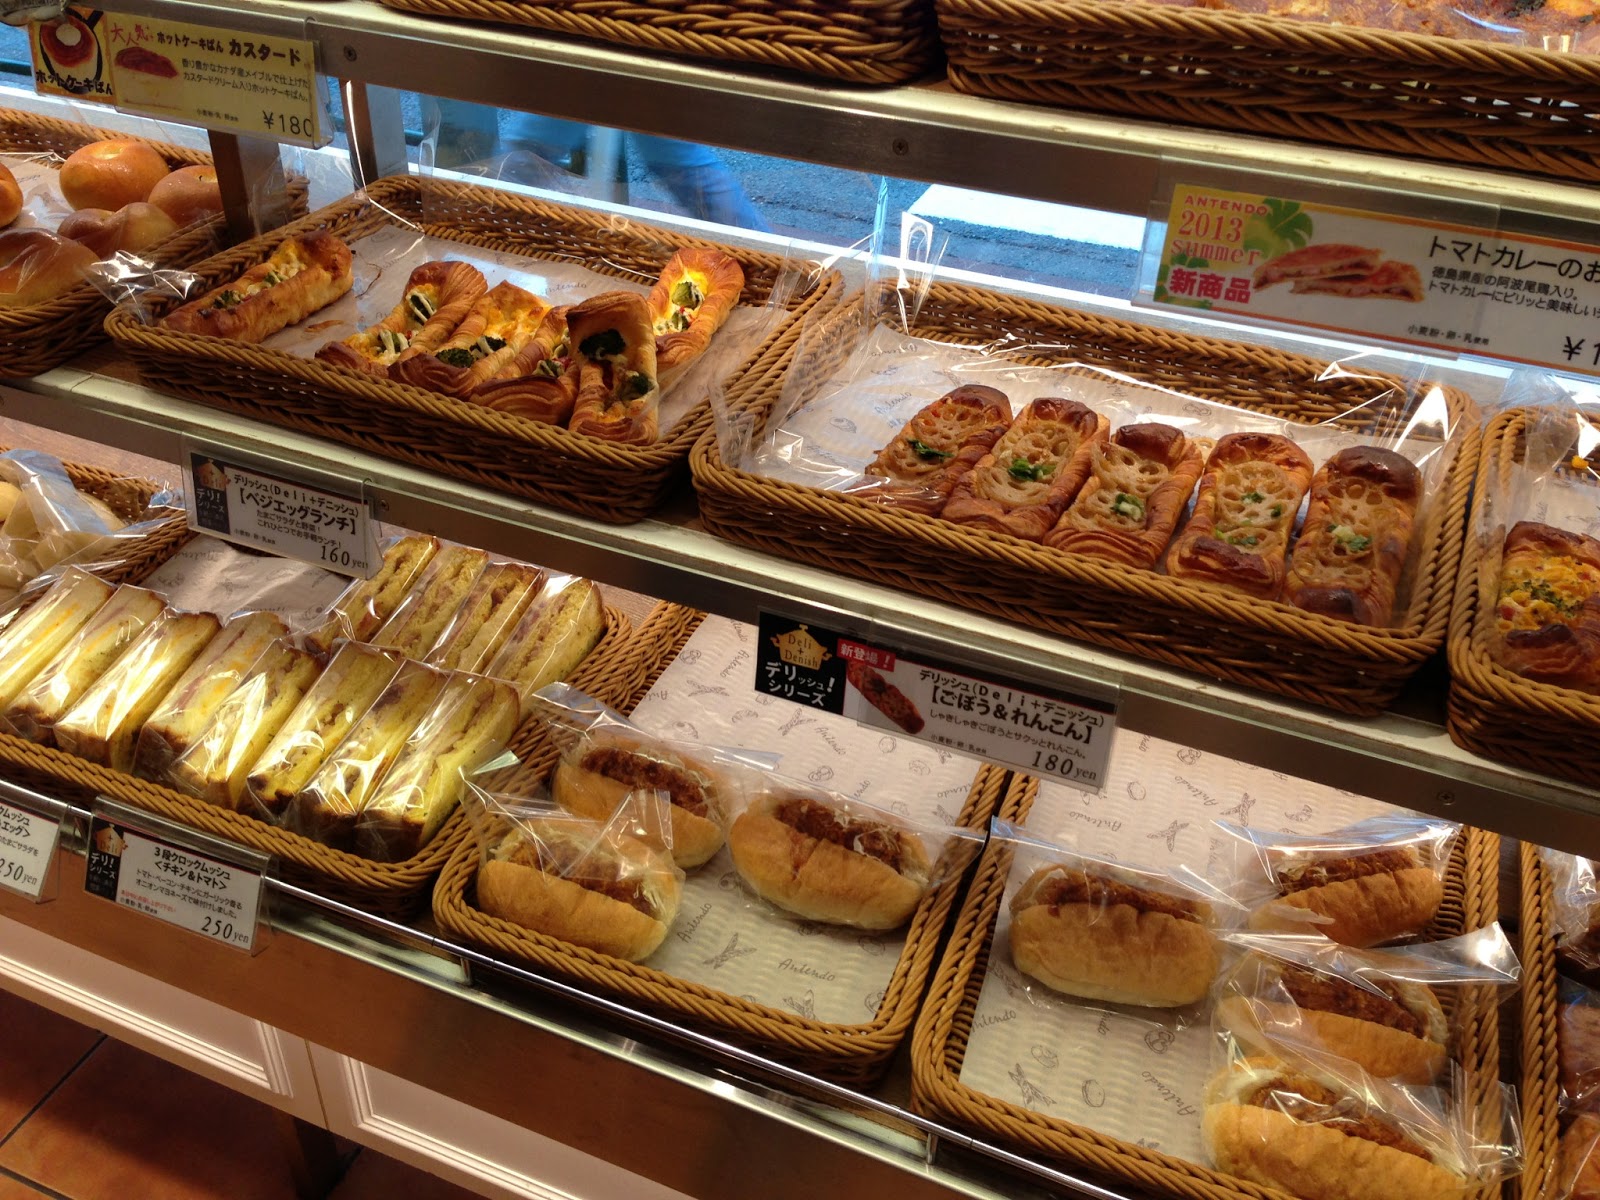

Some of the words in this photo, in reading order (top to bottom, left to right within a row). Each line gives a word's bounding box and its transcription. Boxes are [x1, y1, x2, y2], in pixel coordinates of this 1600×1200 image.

[229, 38, 301, 67] カスタード
[1184, 195, 1269, 216] ANTENDO
[1178, 209, 1244, 243] 2013
[1169, 268, 1251, 304] 新商品
[320, 545, 350, 566] 160
[351, 559, 369, 570] yen
[788, 634, 812, 649] Deli
[784, 649, 819, 667] Denish
[768, 679, 826, 706] シリーズ
[1031, 751, 1074, 776] 180
[1075, 767, 1097, 781] yen
[1069, 811, 1122, 833] Antendo
[22, 873, 38, 886] yen
[201, 916, 233, 939] 250
[232, 930, 249, 943] yen
[676, 902, 713, 944] Antendo
[777, 957, 837, 983] Antendo
[971, 1010, 1017, 1033] ntendo
[1141, 1070, 1196, 1116] Antendo
